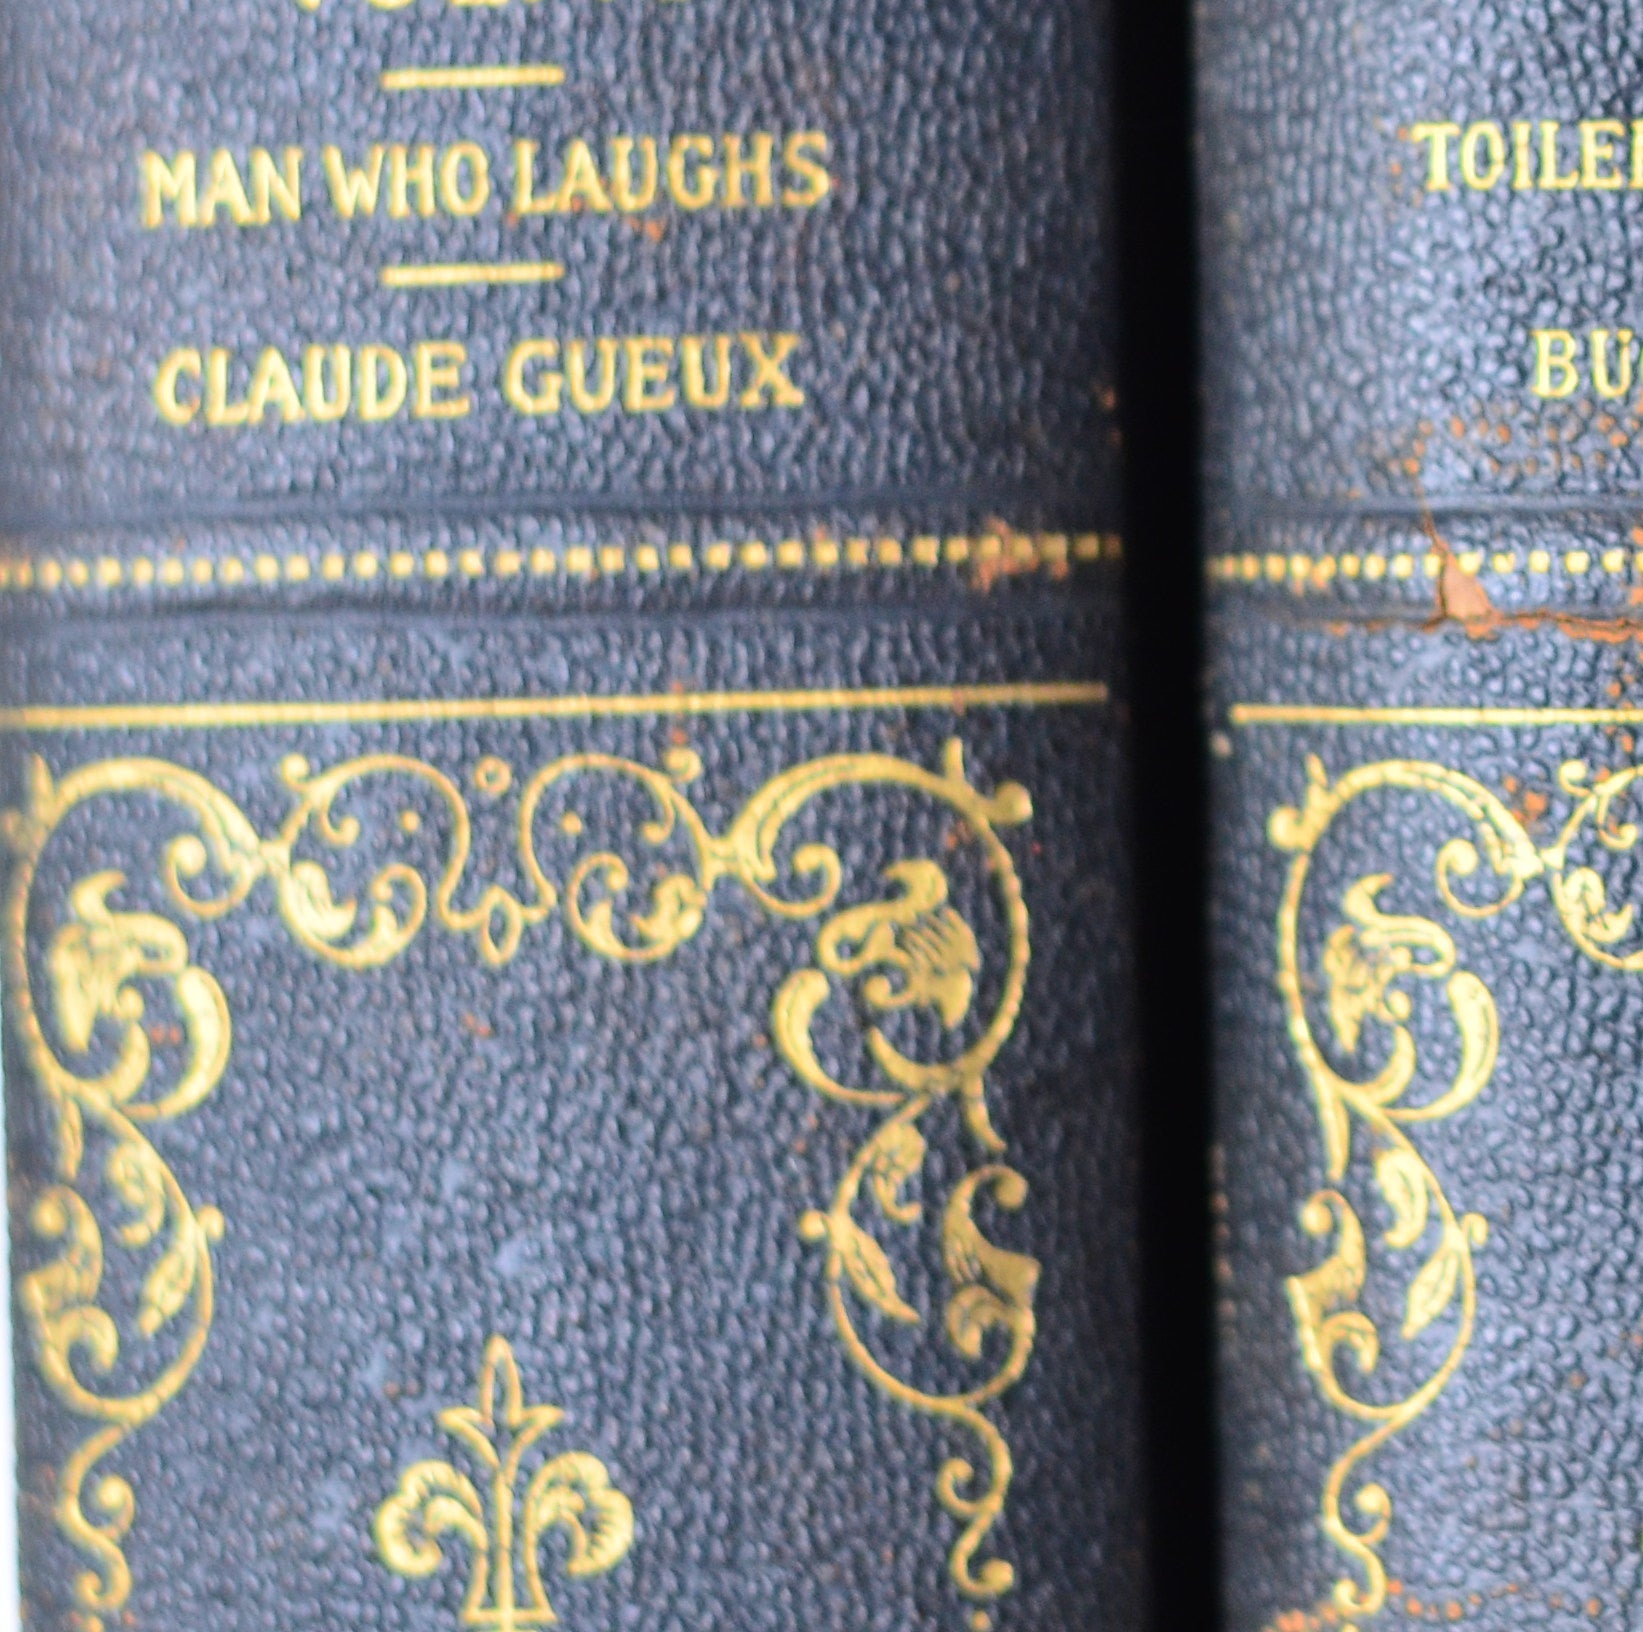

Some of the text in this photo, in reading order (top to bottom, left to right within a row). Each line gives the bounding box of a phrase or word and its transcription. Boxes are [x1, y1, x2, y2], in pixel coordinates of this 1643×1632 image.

[142, 132, 830, 227] MAN WHO LAUGHS
[154, 333, 804, 426] CLAUDE GUEUX
